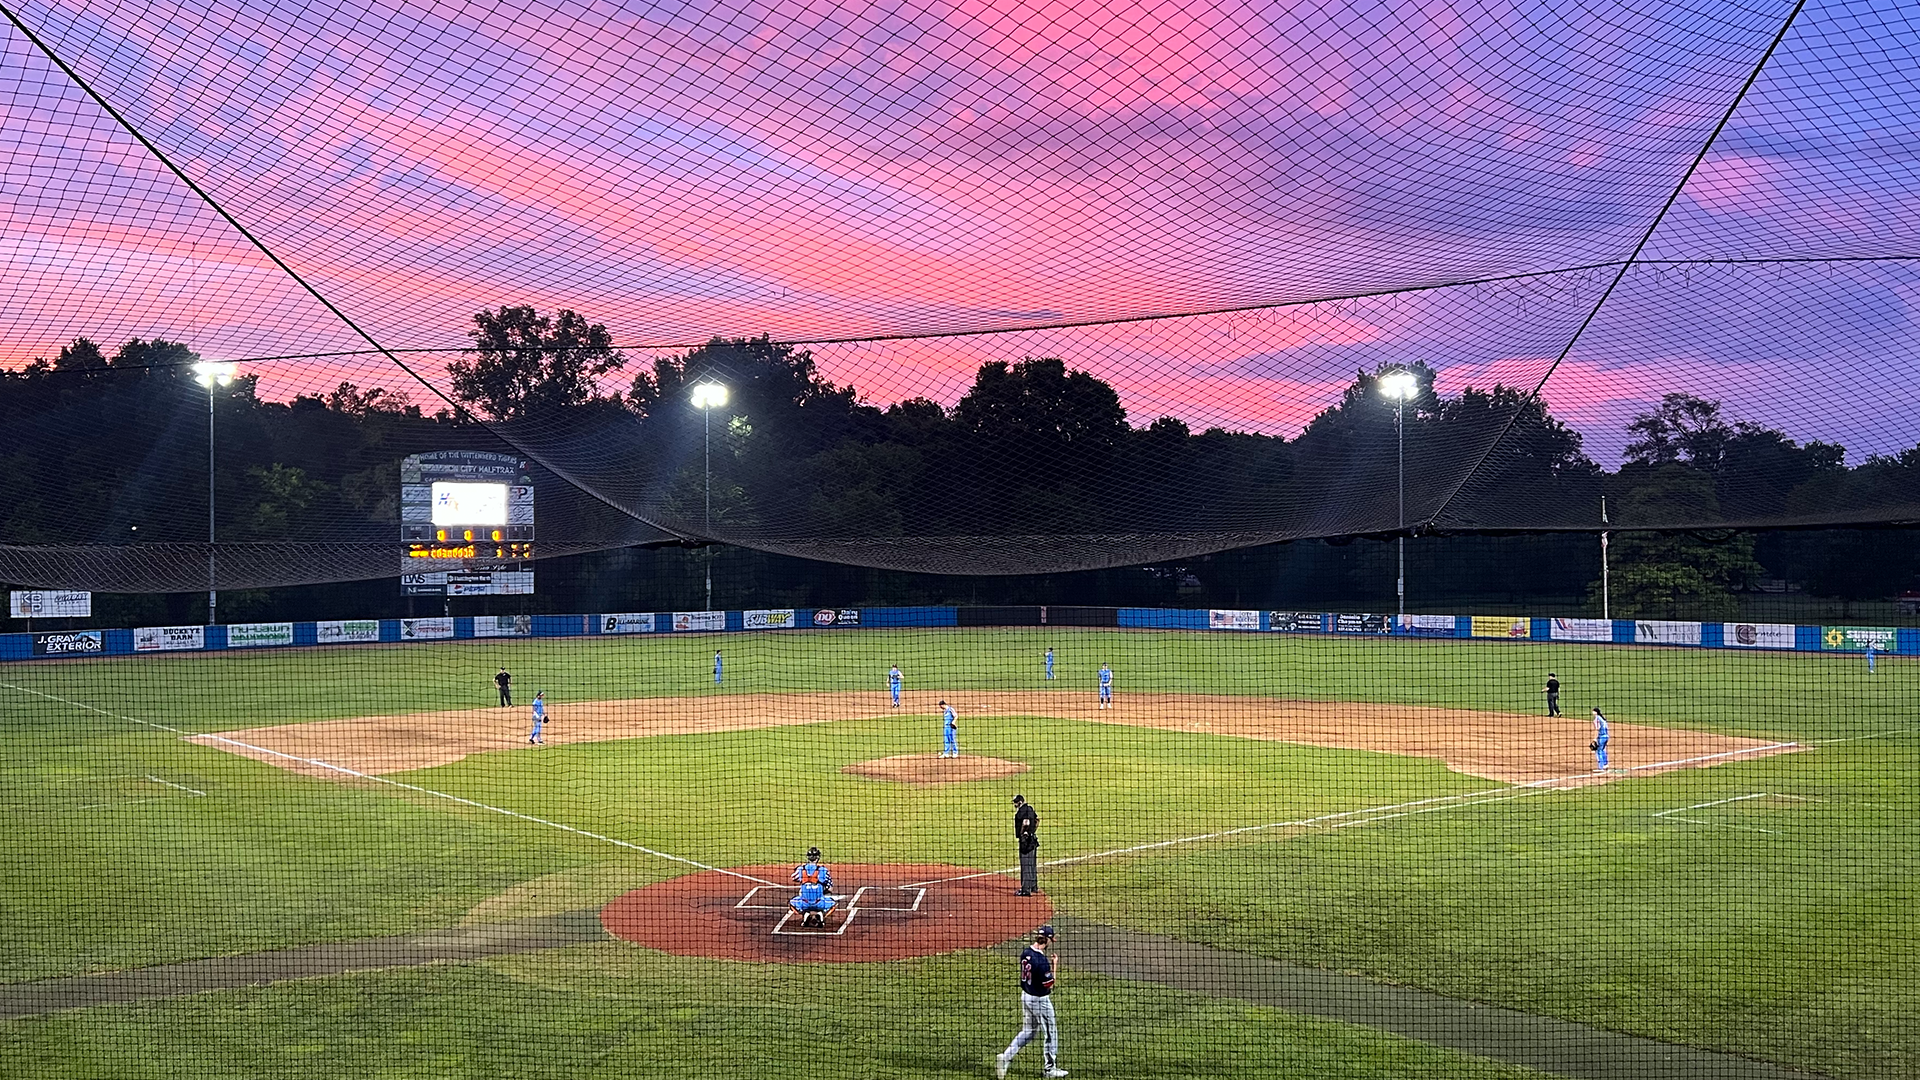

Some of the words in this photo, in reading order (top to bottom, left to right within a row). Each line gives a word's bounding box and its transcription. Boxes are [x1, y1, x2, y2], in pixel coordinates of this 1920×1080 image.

[460, 464, 477, 473] CITY
[478, 465, 515, 474] HALFTRAX
[745, 611, 792, 627] SUBWAY
[817, 613, 832, 621] DQ
[1846, 630, 1893, 639] SUNBELT
[46, 641, 101, 651] EXTERIOR
